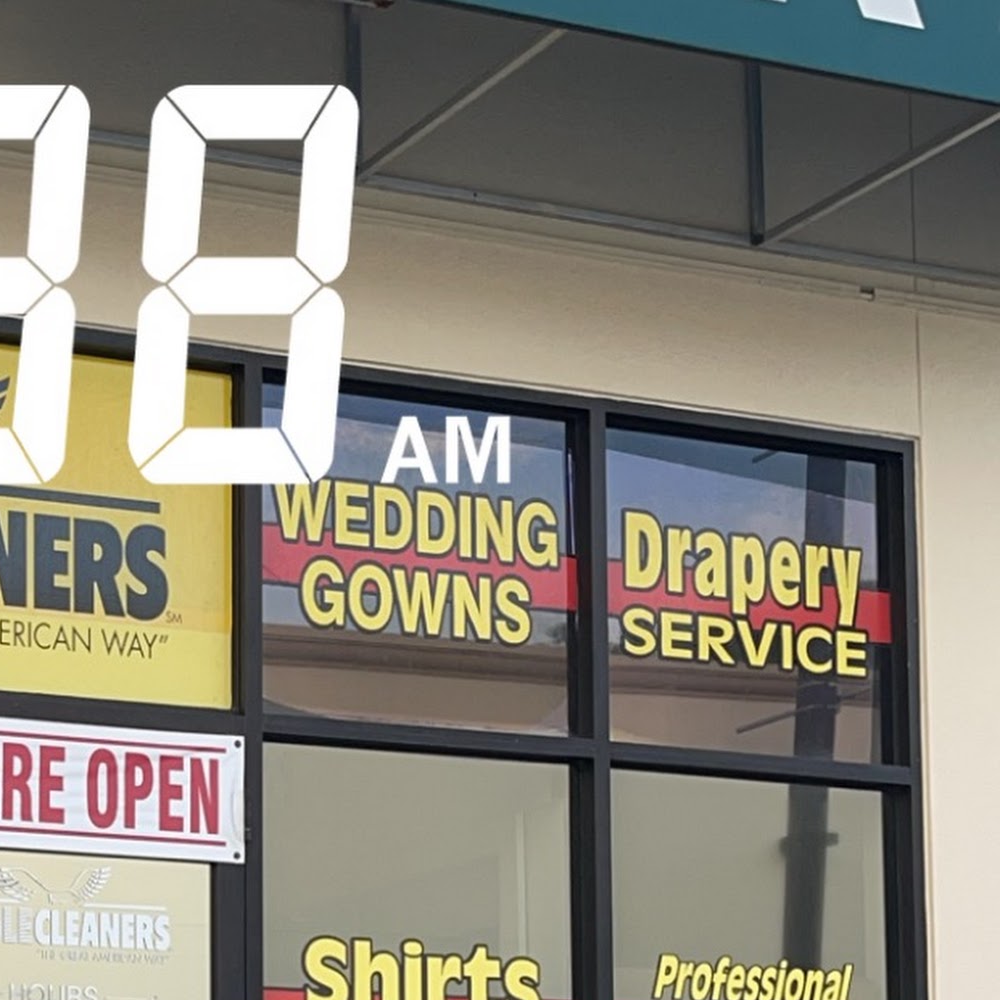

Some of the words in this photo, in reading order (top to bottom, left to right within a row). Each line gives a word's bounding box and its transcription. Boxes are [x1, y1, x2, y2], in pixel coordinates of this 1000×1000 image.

[273, 479, 560, 569] WEDDING
[299, 556, 533, 646] GOWNS
[622, 509, 864, 628] Drapery
[622, 606, 870, 678] SERVICE
[86, 748, 219, 835] OPEN
[34, 908, 172, 951] CLEANERS
